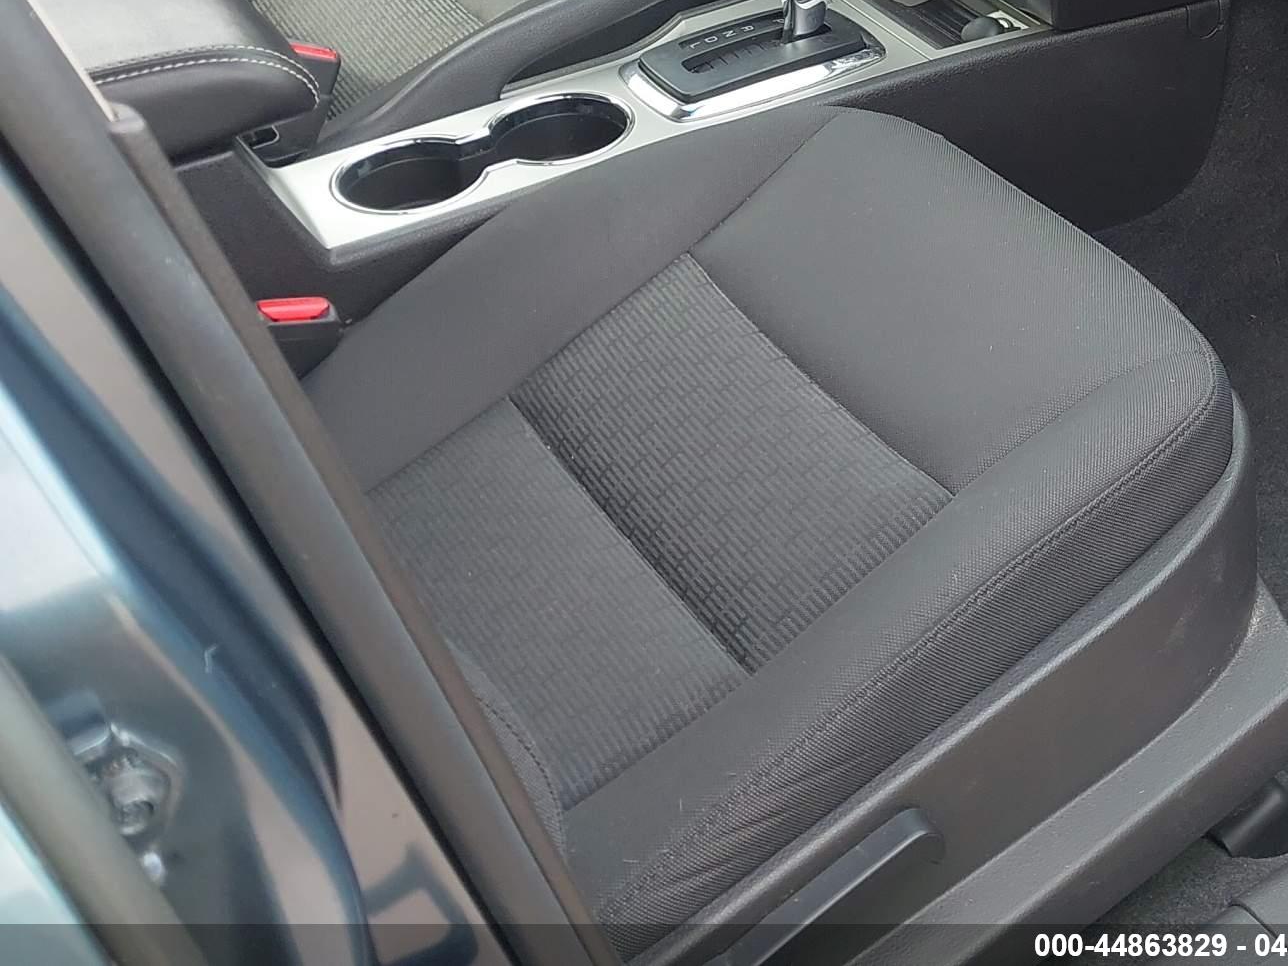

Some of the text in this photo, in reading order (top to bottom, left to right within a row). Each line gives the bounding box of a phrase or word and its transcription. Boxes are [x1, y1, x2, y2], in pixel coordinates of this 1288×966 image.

[722, 30, 737, 38] N
[704, 35, 718, 43] D
[689, 41, 701, 49] L
